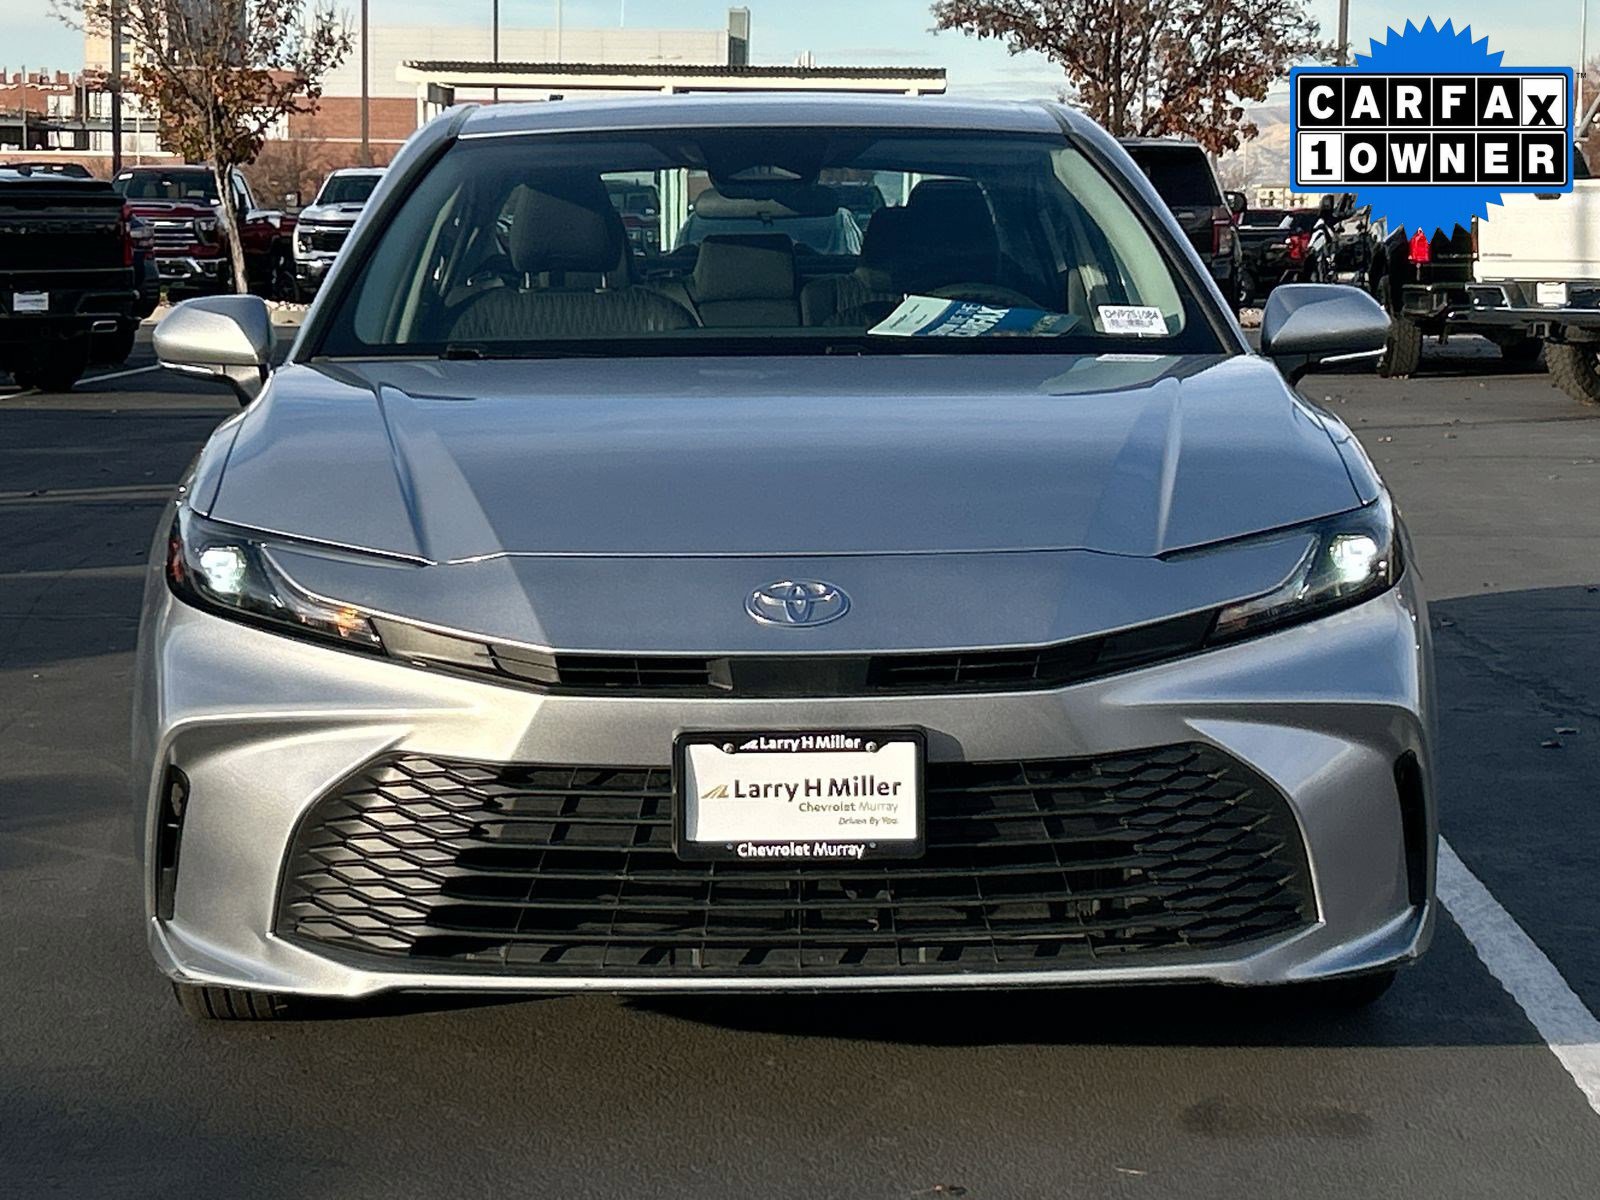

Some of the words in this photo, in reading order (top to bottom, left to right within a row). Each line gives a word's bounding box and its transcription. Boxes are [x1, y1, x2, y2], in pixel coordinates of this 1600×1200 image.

[760, 736, 800, 752] Larry
[801, 736, 813, 748] H
[815, 735, 861, 749] Miller
[734, 779, 799, 802] Larry
[804, 779, 822, 797] H
[828, 775, 902, 797] Miller
[799, 802, 856, 812] Chevrolet
[859, 802, 899, 813] Murray
[737, 842, 811, 857] Chevrolet
[813, 842, 865, 859] Murray
